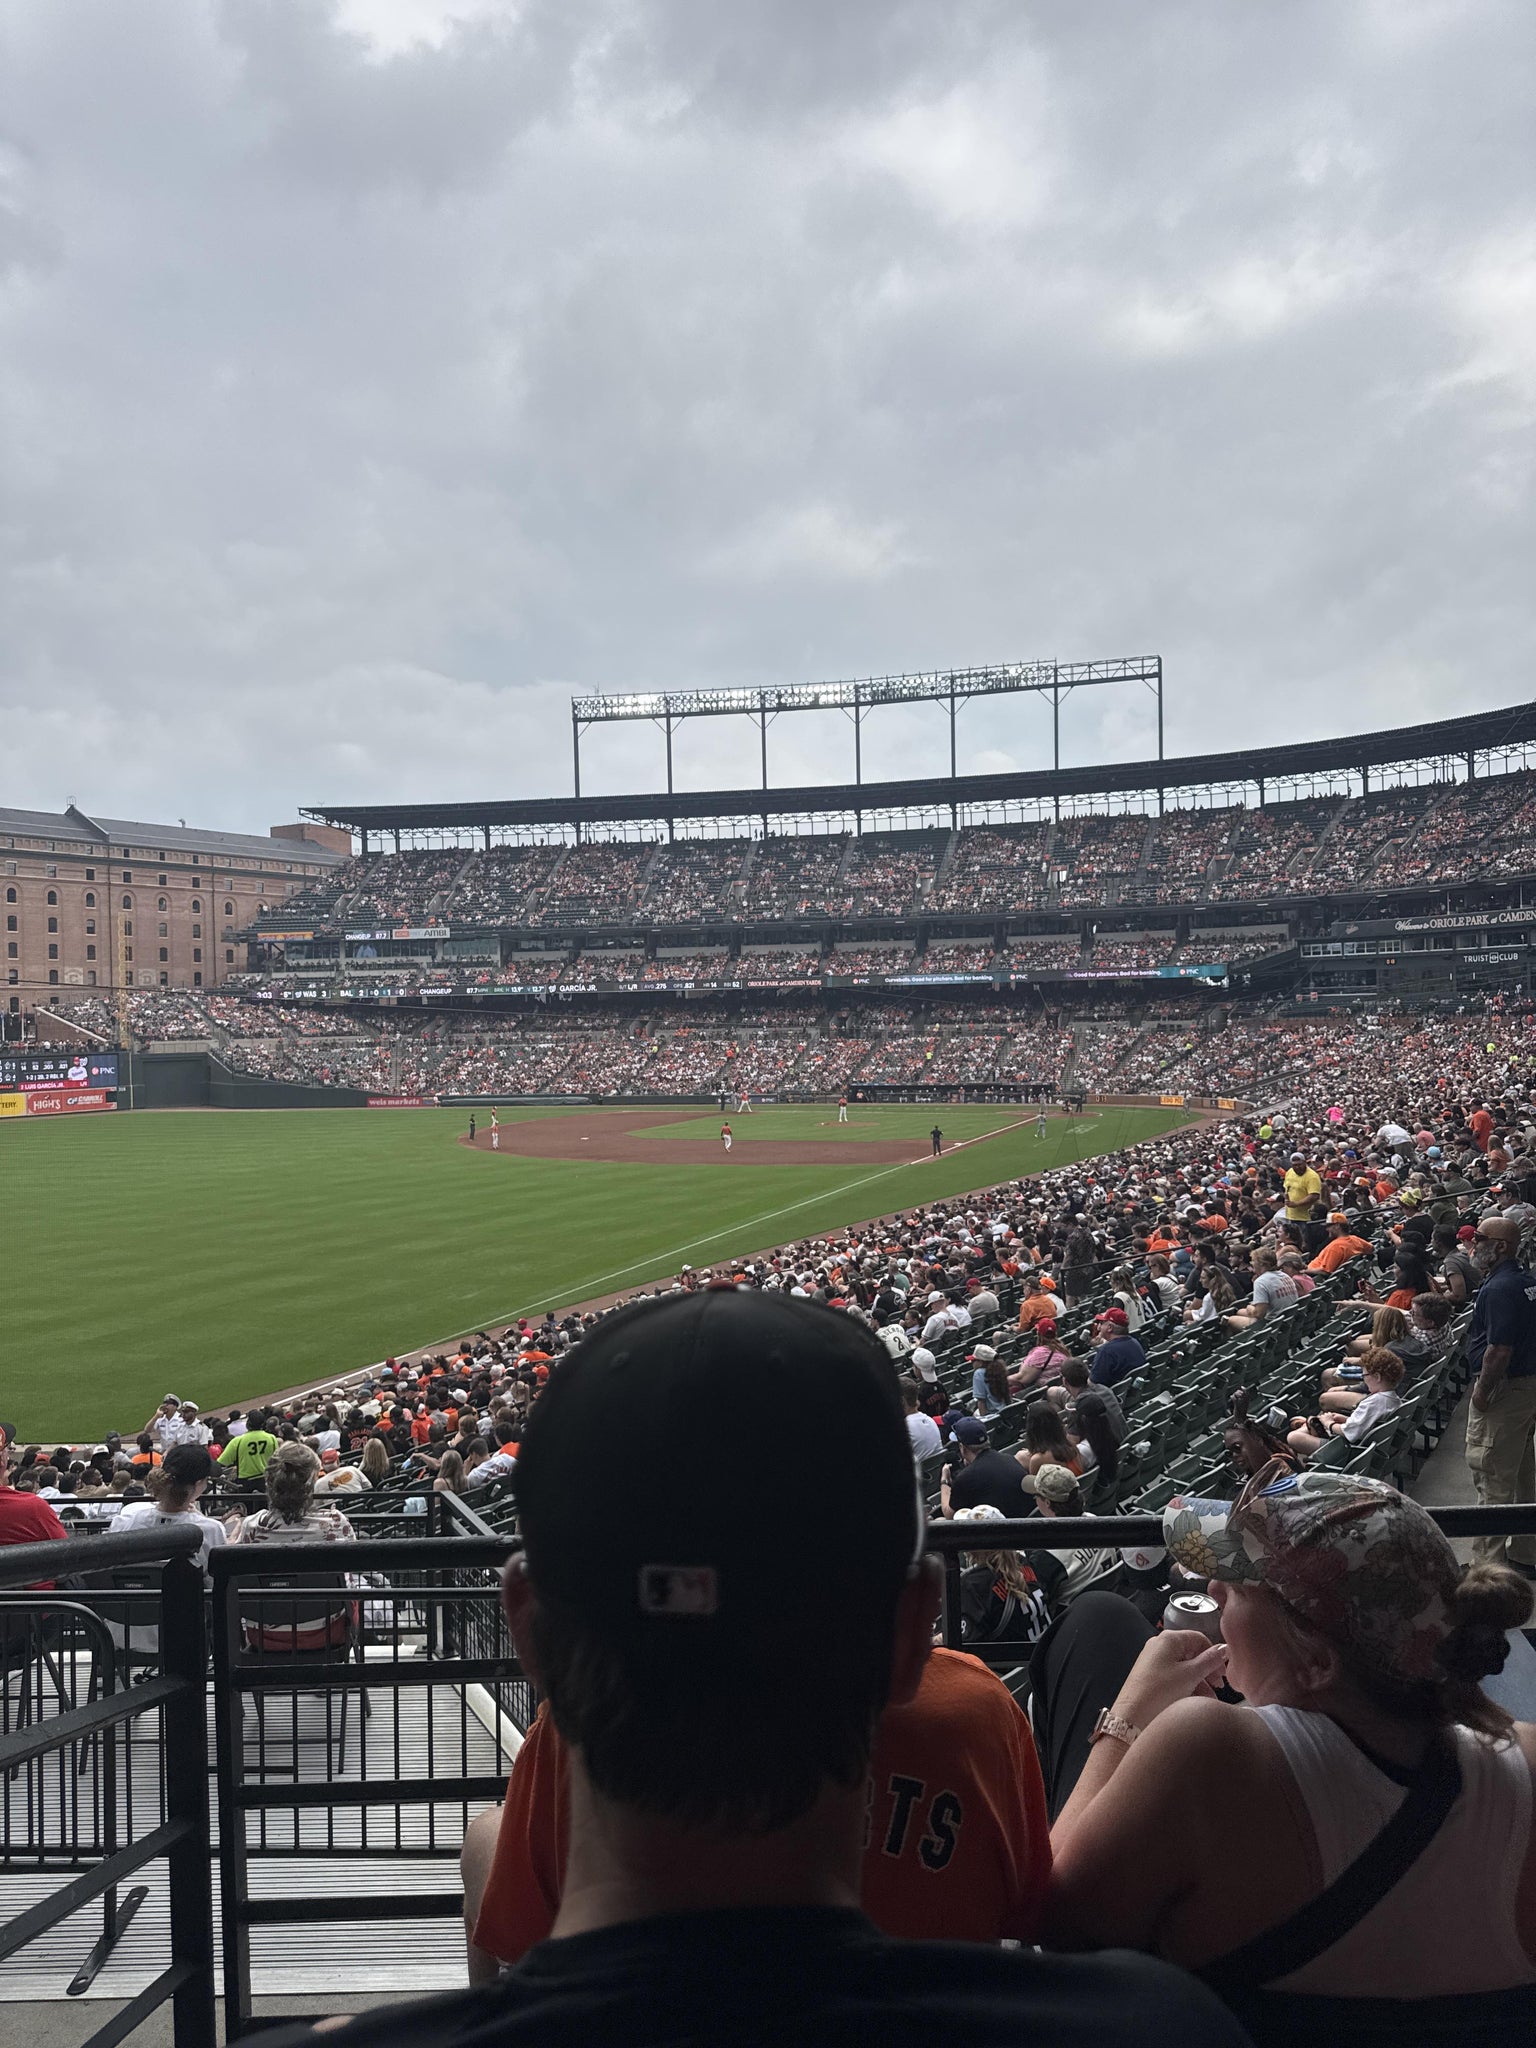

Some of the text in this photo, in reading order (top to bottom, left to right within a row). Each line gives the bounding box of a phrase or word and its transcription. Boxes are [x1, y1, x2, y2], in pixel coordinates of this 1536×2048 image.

[1430, 918, 1464, 929] ORIOLE
[1465, 915, 1489, 926] PARK
[1464, 952, 1518, 963] TRUIST CLUB
[560, 984, 586, 992] GARCÍA
[303, 990, 316, 998] WAS
[33, 1099, 61, 1111] HIGH'S
[369, 1098, 386, 1106] weis
[893, 1336, 905, 1351] 2
[247, 1440, 267, 1456] 37
